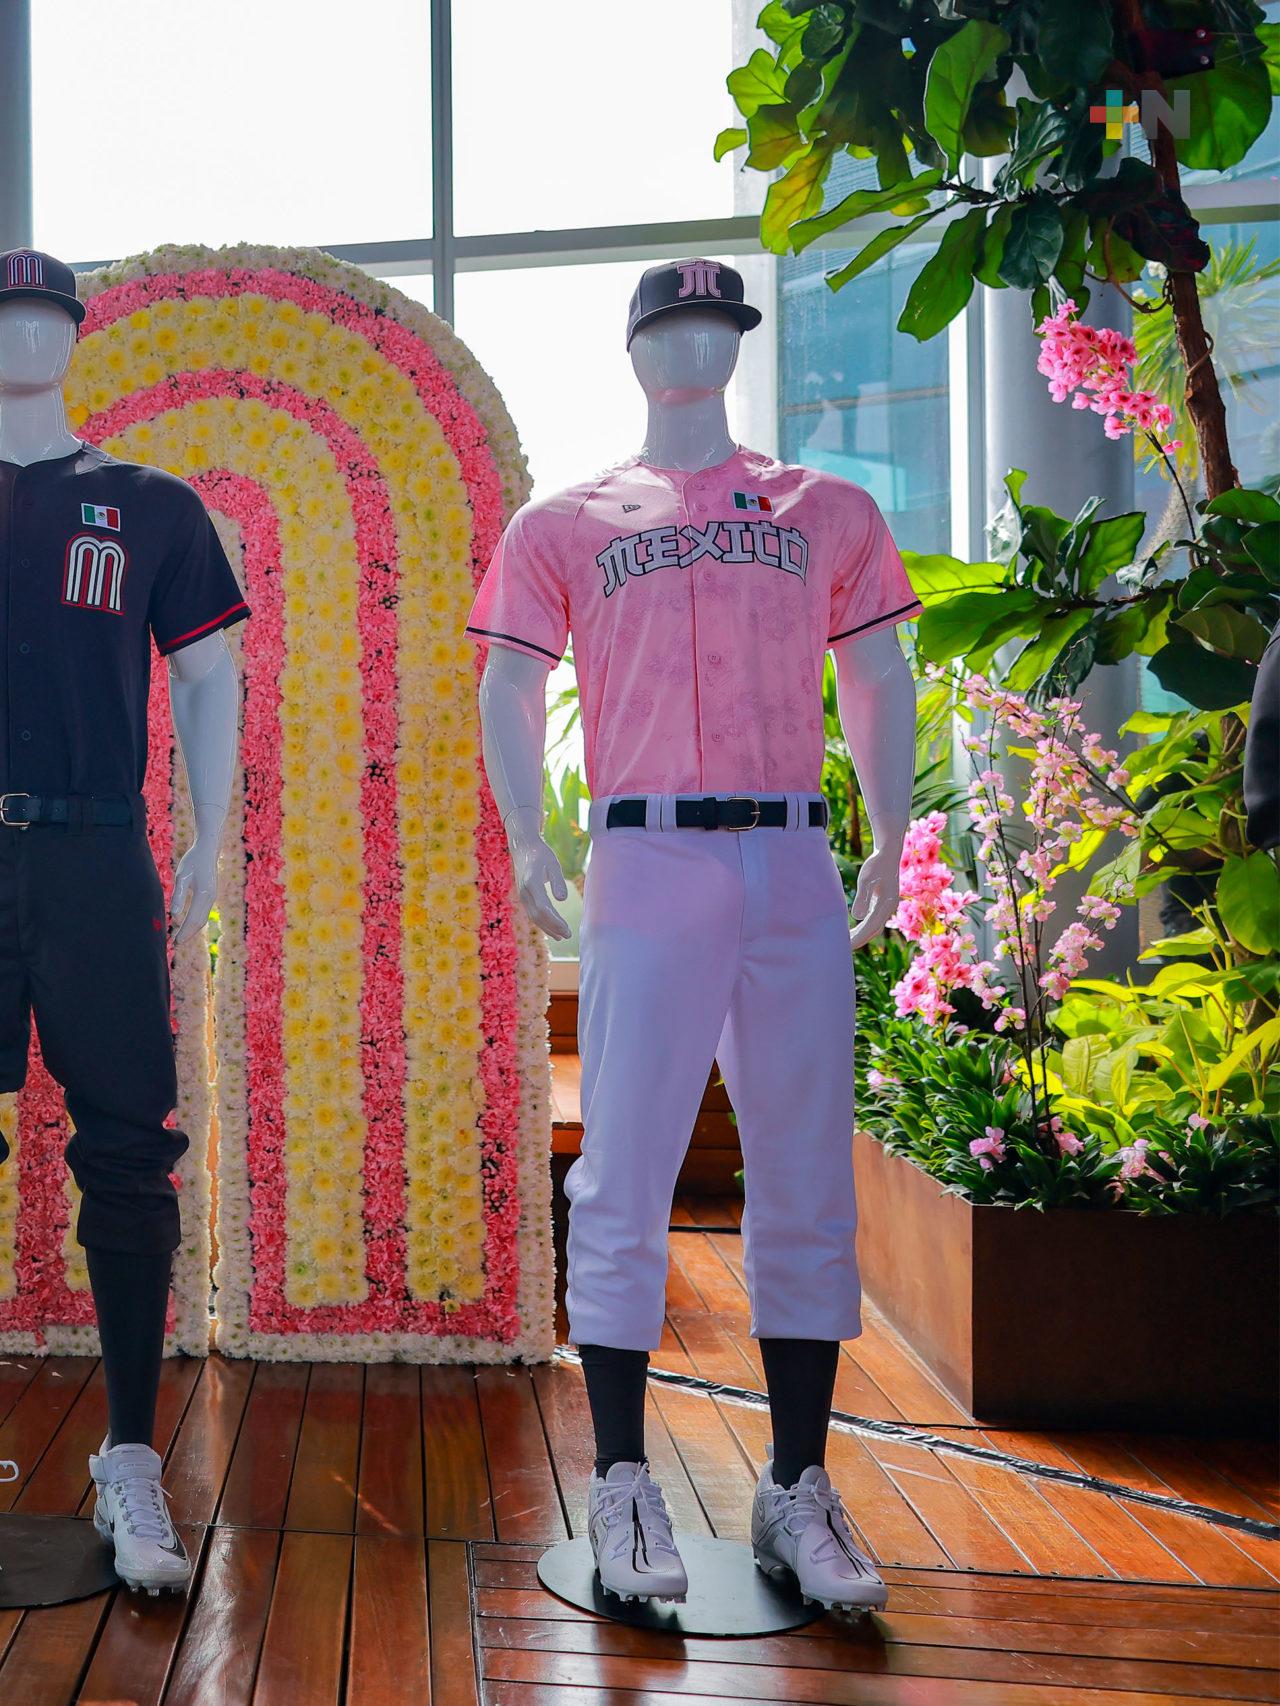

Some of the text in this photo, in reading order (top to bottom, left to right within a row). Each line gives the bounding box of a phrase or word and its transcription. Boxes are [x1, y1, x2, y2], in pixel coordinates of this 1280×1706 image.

[7, 252, 45, 288] M
[61, 532, 128, 615] M
[596, 520, 808, 598] MEXICO
